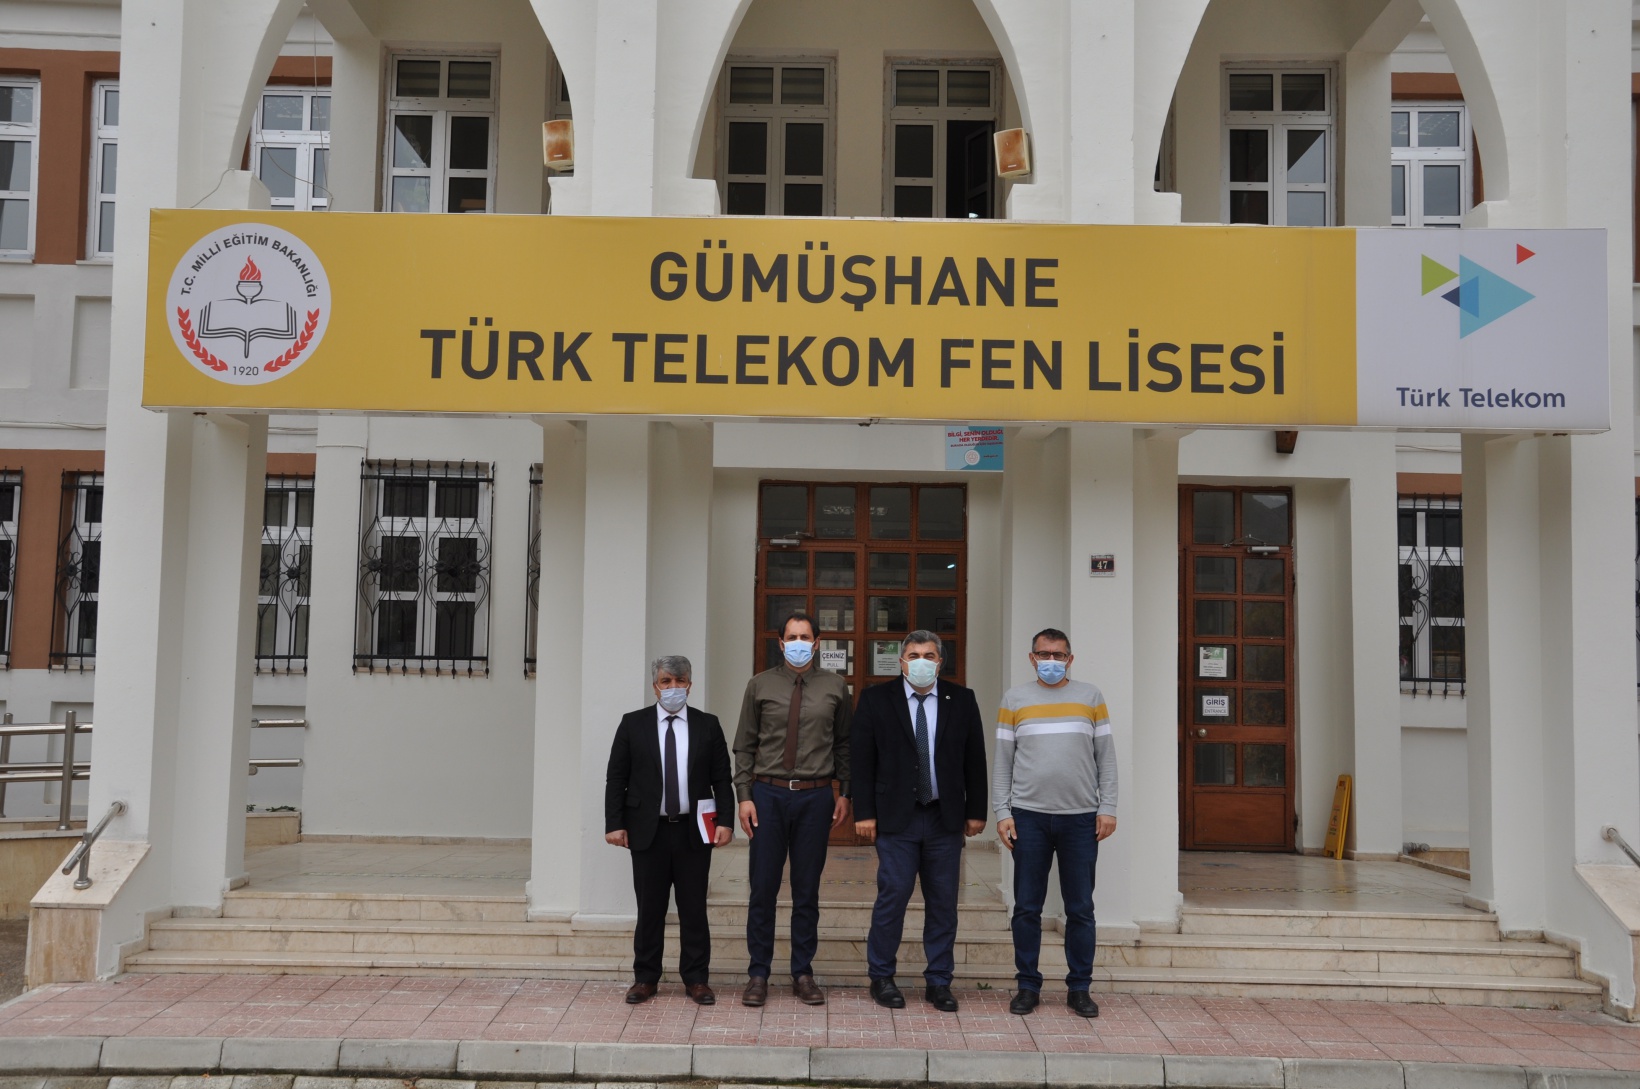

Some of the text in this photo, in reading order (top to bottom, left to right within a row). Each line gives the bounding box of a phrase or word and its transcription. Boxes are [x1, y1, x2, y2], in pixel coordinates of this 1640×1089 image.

[180, 232, 319, 298] T.C. MİLLİ EĞİTİM BAKANLIĞI
[649, 239, 1059, 312] GÜMÜŞHANE
[419, 316, 1285, 396] TÜRK TELEKOM FEN LİSESİ
[232, 366, 259, 376] 1920
[1396, 387, 1566, 408] Türk Telekom
[1097, 561, 1108, 570] 47
[821, 652, 845, 660] ÇEKİNİZ
[1205, 697, 1226, 706] GİRİŞ
